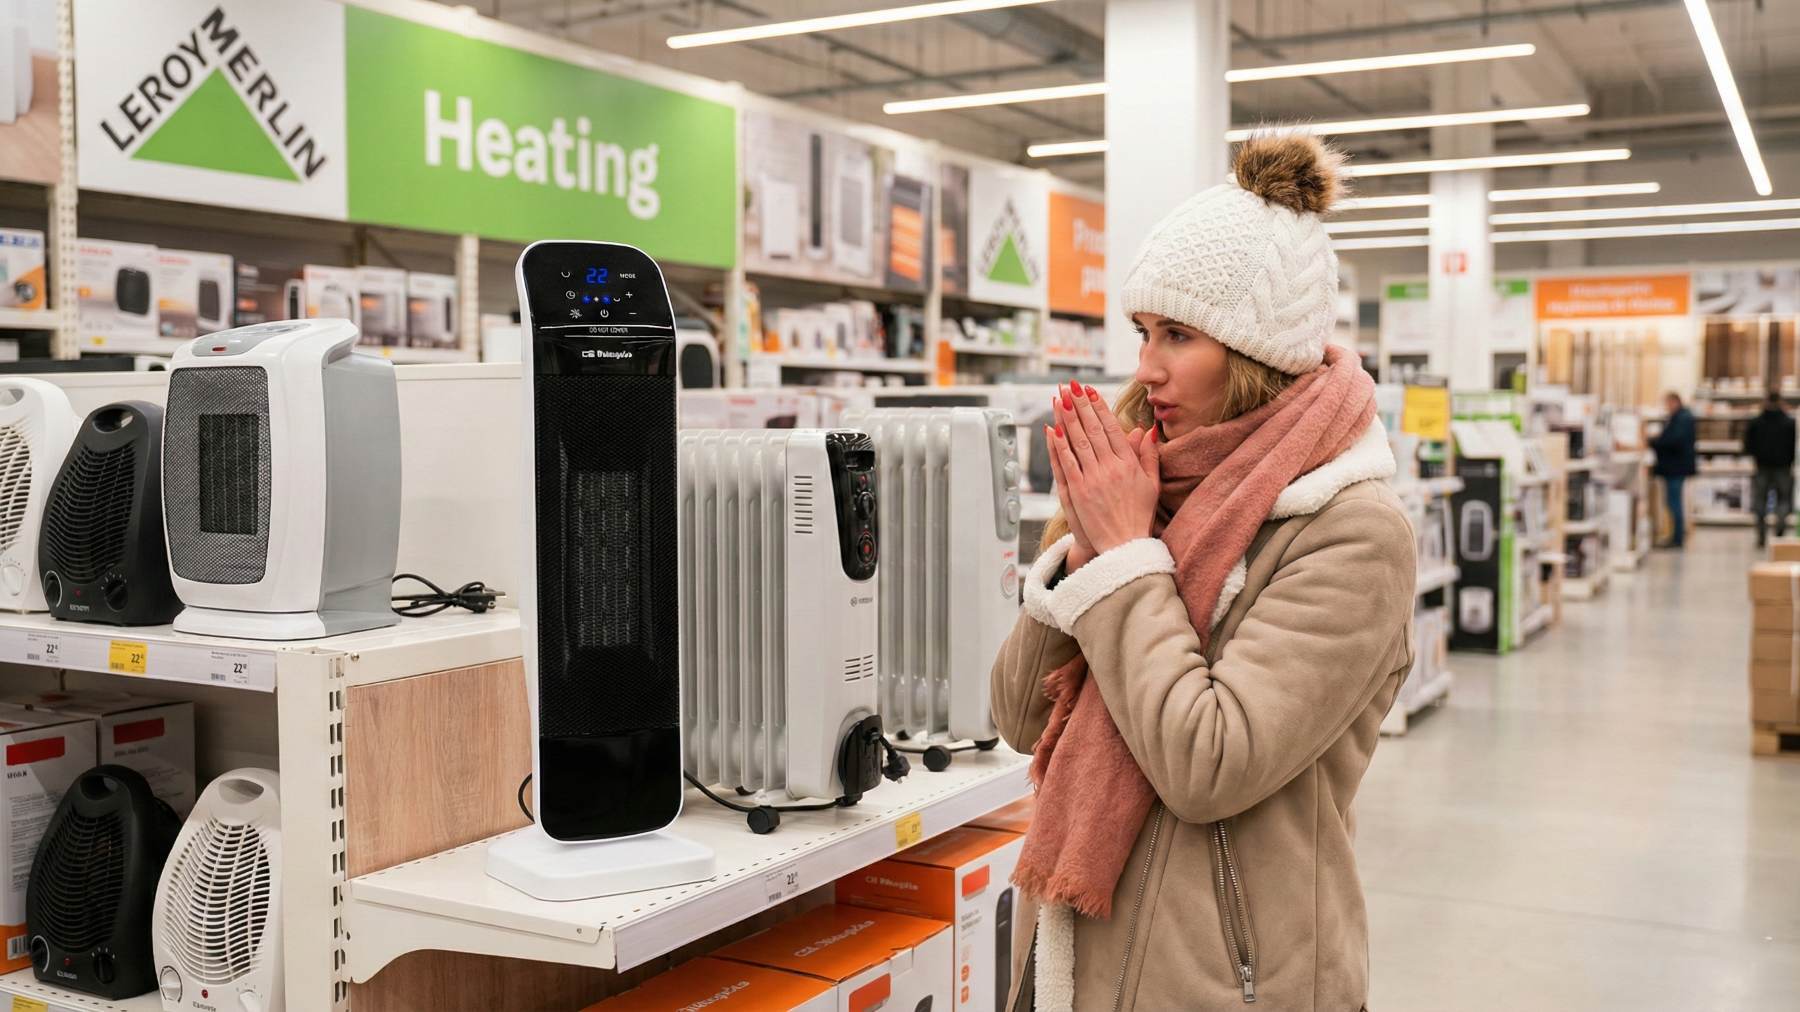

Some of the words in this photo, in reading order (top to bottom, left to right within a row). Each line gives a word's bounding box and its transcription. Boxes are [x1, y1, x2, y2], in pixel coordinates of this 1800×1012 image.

[100, 30, 208, 152] LEROY
[200, 6, 327, 179] MERLIN
[423, 88, 662, 221] Heating
[585, 267, 608, 284] 22
